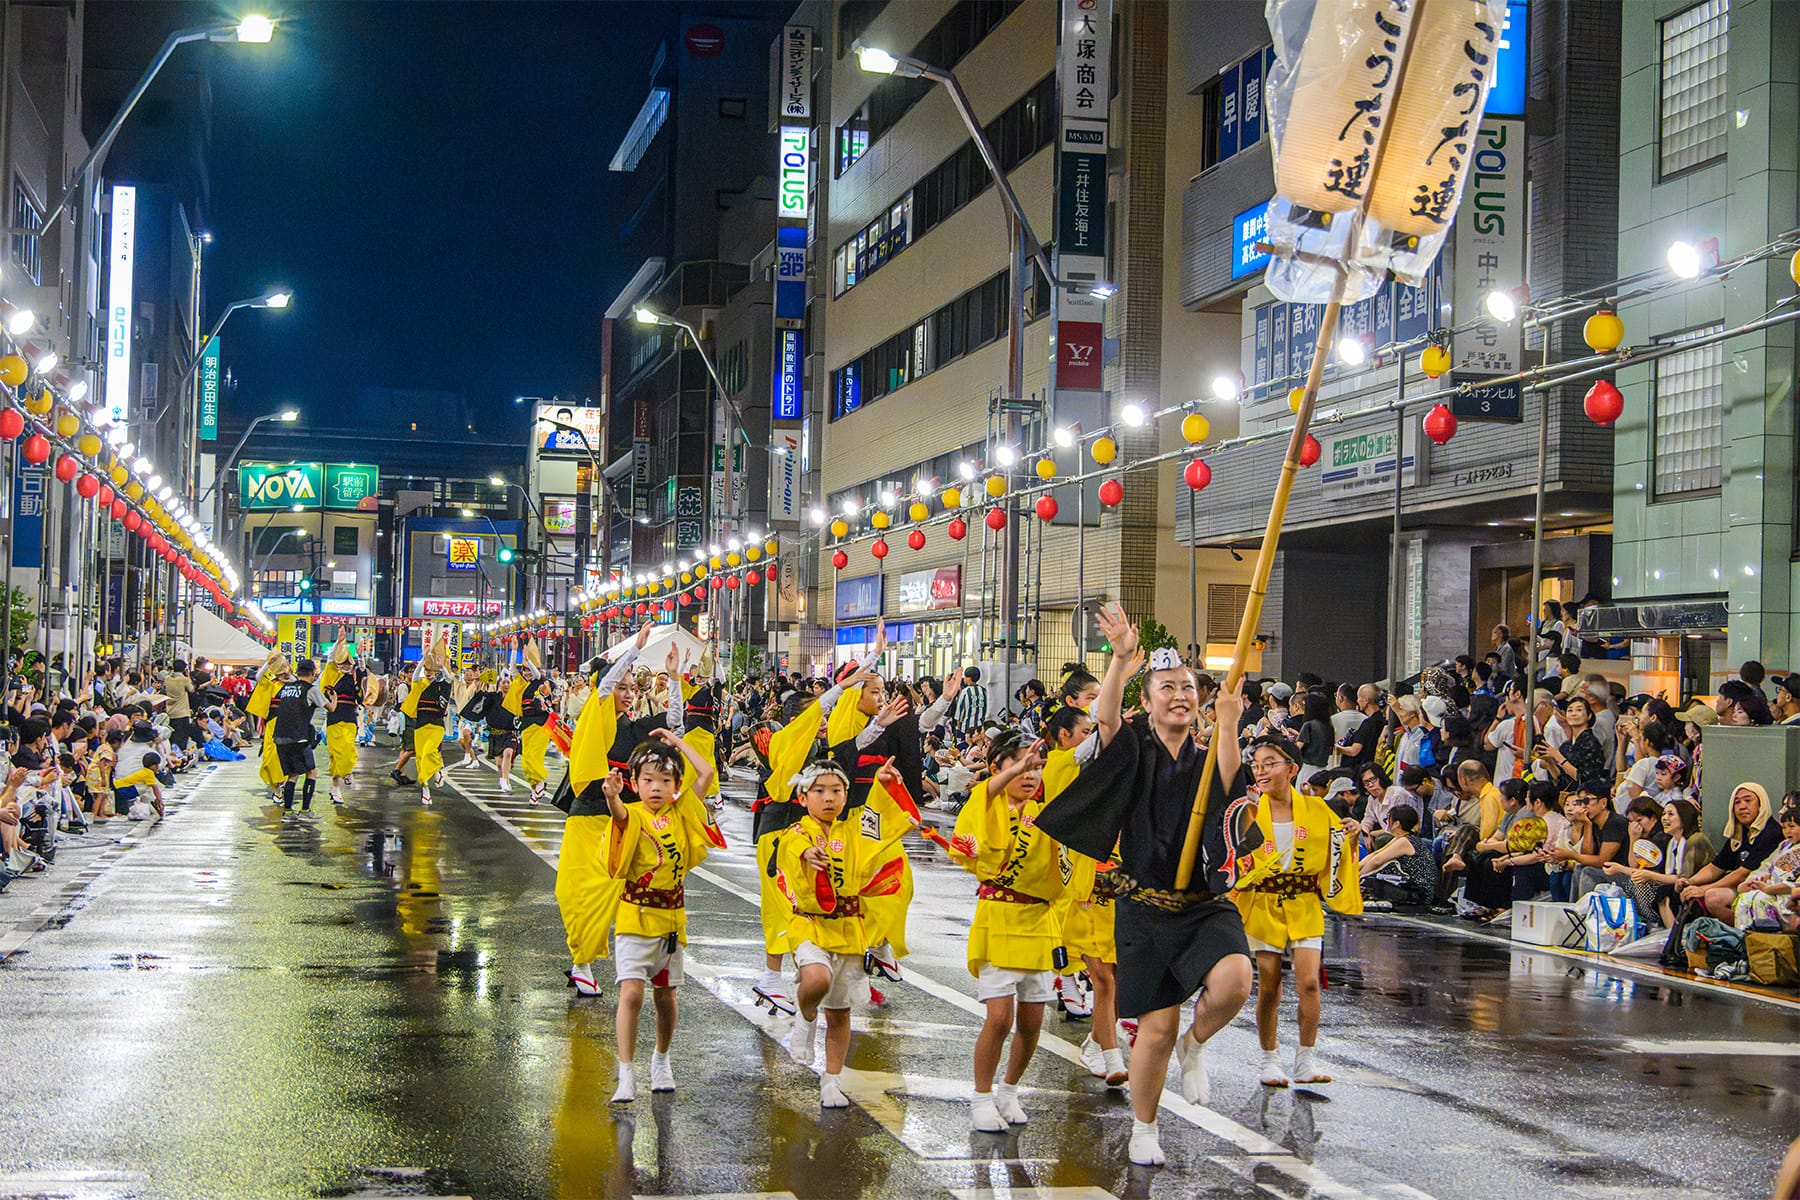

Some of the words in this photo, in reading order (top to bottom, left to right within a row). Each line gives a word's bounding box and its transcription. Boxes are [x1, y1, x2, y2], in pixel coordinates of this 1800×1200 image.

[1076, 15, 1097, 108] 大塚商会
[784, 136, 806, 210] POLUS
[1473, 125, 1507, 236] POLUS
[1074, 158, 1090, 247] 三井住友海上
[780, 252, 804, 262] YKK
[780, 263, 804, 276] ap
[1065, 342, 1094, 360] Y!
[203, 356, 217, 426] 明治安田生命
[1480, 401, 1491, 412] 3
[248, 473, 316, 503] NOVA
[784, 435, 797, 515] Prime-one
[453, 541, 474, 562] 薬
